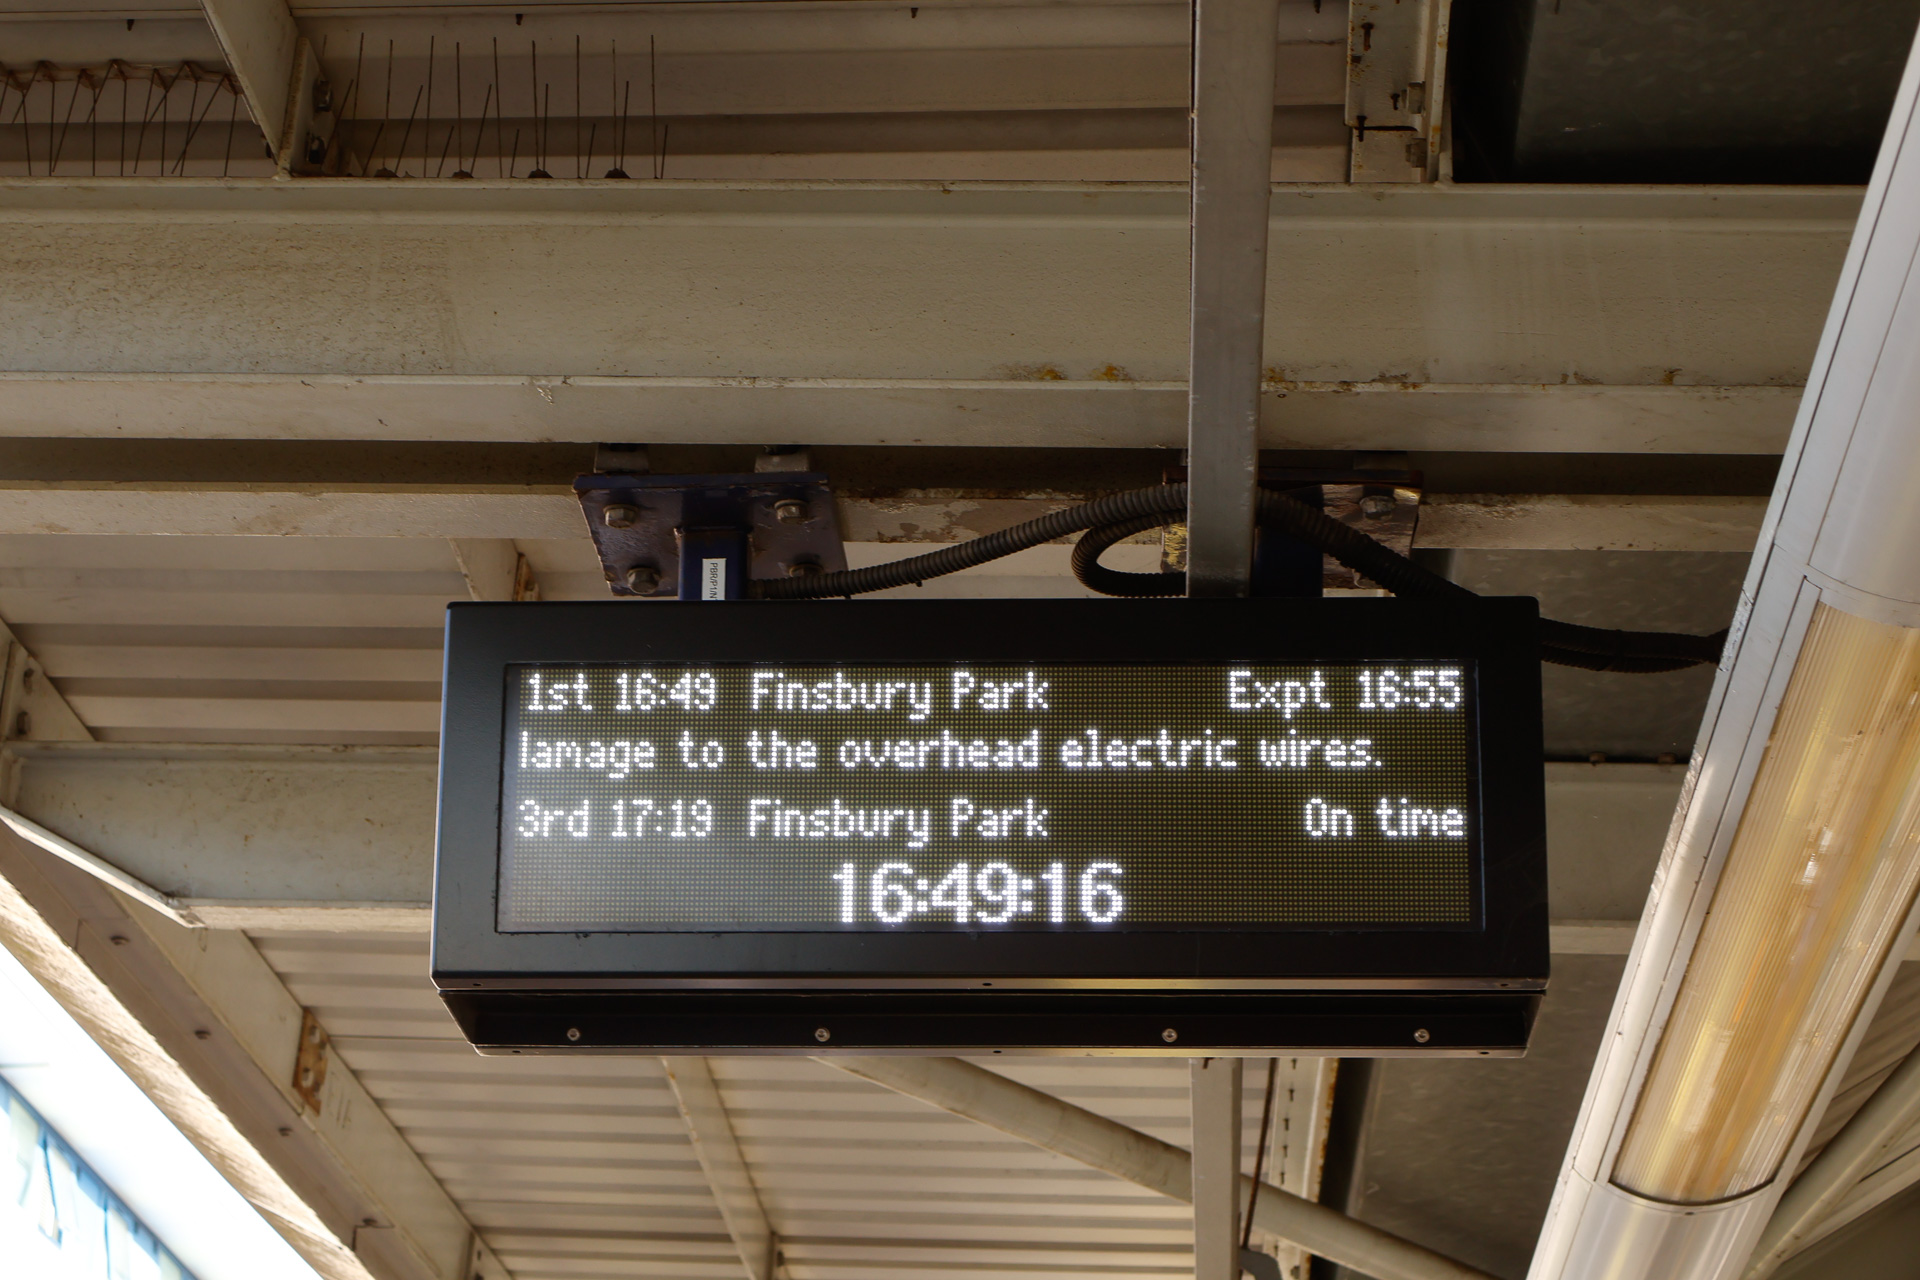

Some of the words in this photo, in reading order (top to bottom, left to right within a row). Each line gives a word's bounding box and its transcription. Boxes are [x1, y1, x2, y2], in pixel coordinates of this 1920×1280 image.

[709, 562, 718, 600] PBR/P1/N
[527, 673, 593, 713] 1st
[614, 673, 718, 713] 16:49
[751, 672, 932, 720] Finsbury
[952, 671, 1048, 712] Park
[1228, 670, 1331, 719] Expt
[1358, 670, 1462, 709] 16:55
[677, 730, 725, 769] to
[747, 730, 819, 769] the
[838, 729, 1041, 769] overhead
[1060, 729, 1238, 768] electric
[1258, 729, 1384, 768] wires.
[517, 799, 591, 838] 3rd
[610, 799, 714, 838] 17:19
[748, 798, 931, 849] Finsbury
[951, 798, 1048, 838] Park
[1303, 797, 1354, 838] On
[1376, 797, 1465, 838] time
[832, 860, 1125, 925] 16:49:16
